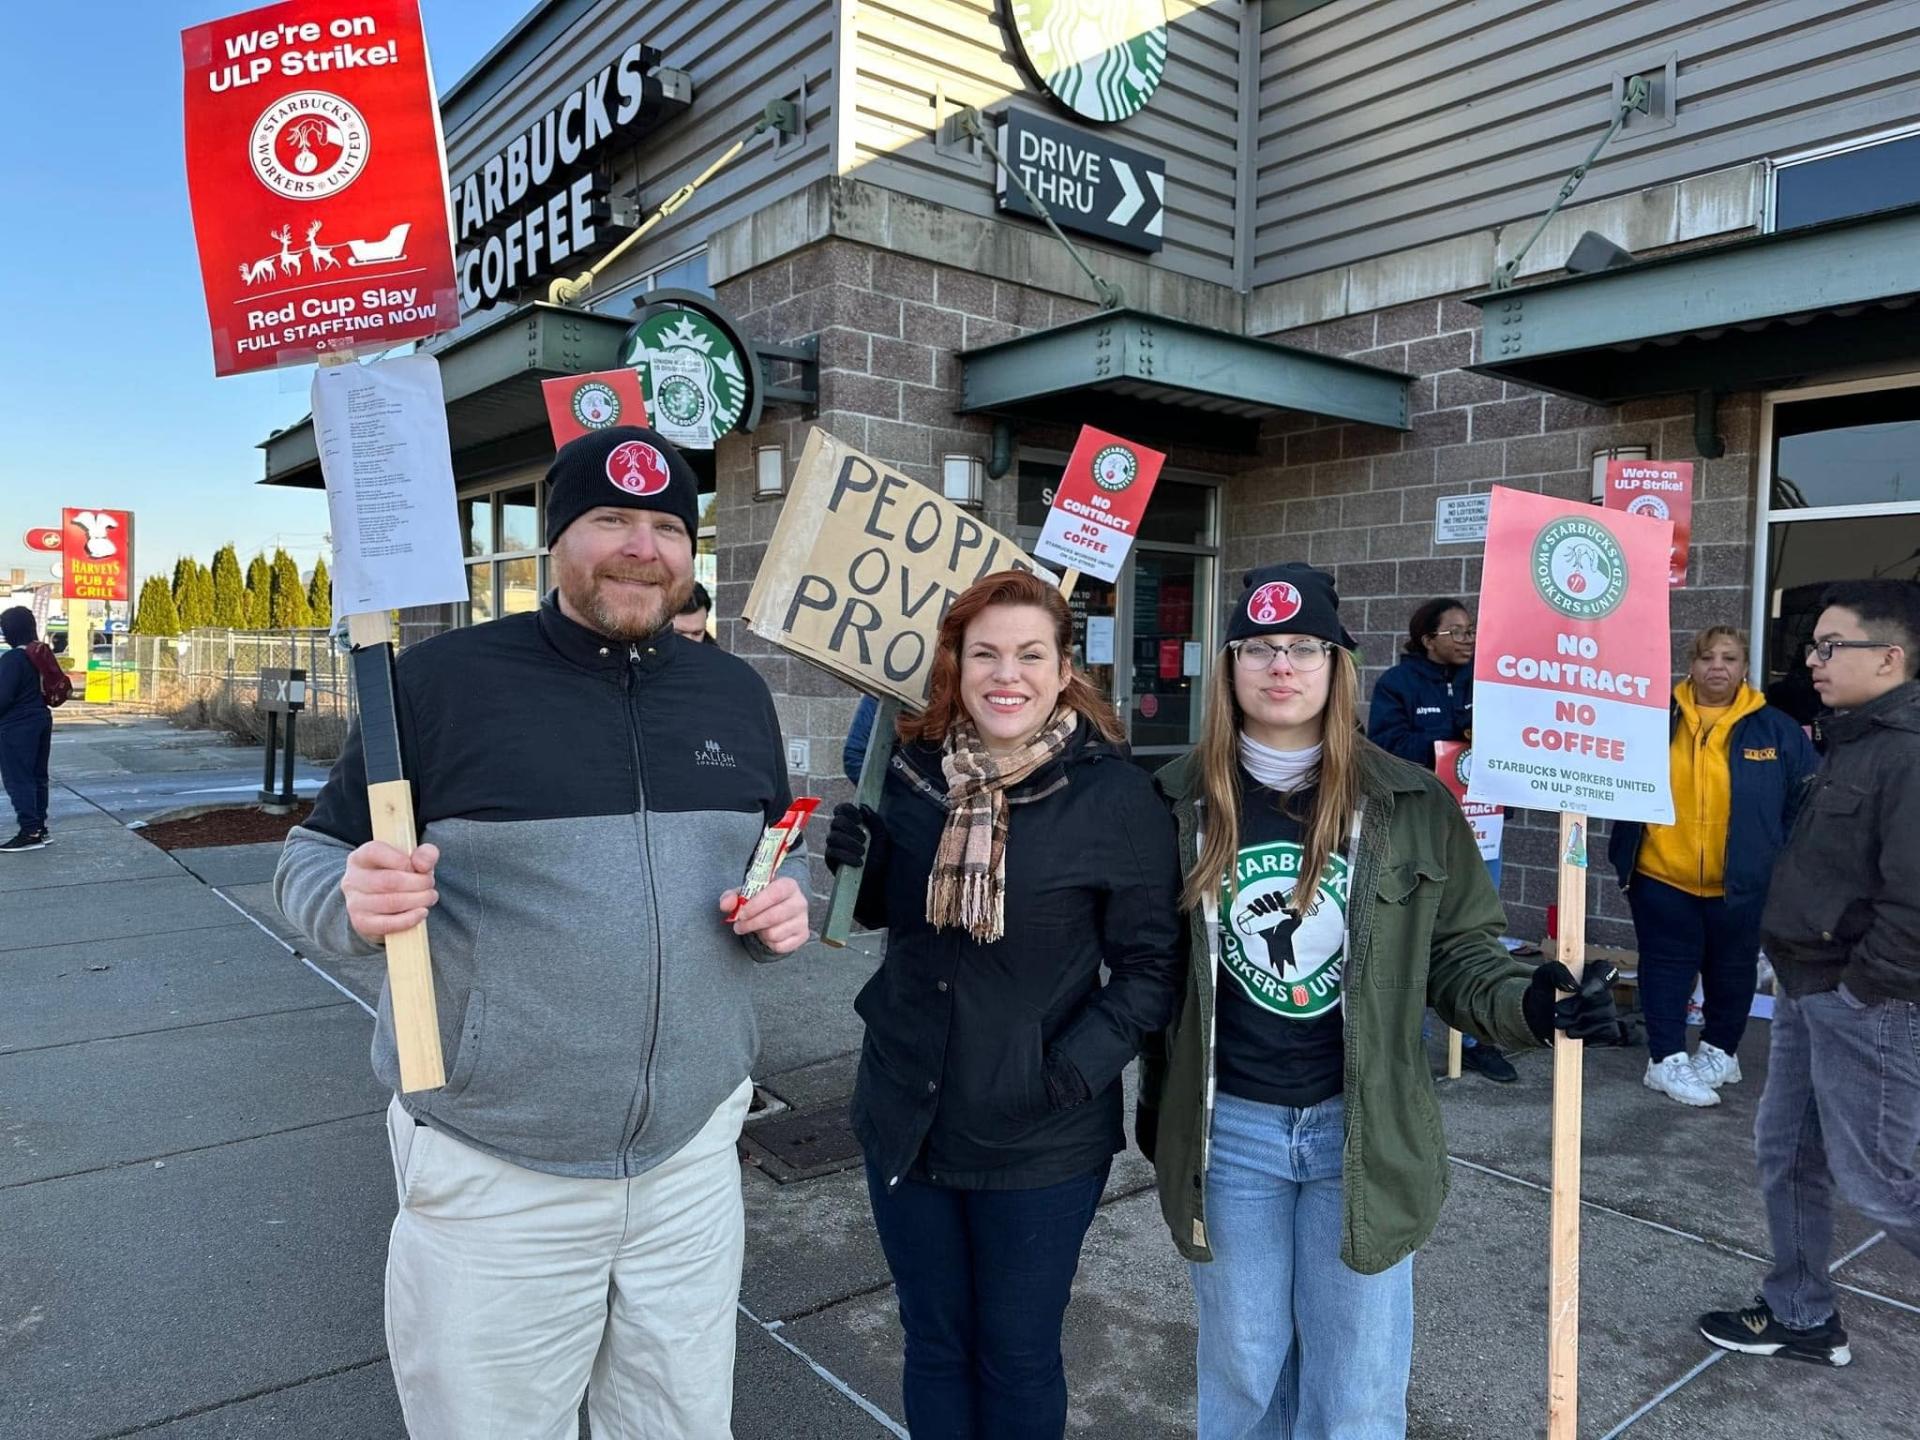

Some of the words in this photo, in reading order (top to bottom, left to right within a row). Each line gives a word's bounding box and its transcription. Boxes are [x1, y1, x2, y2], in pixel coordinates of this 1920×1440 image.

[225, 24, 321, 59] We're
[329, 15, 376, 42] on
[209, 56, 273, 93] ULP
[281, 41, 399, 77] Strike!
[264, 98, 352, 134] STARBUCKS
[326, 131, 362, 187] UNITED
[450, 43, 643, 244] TARBUCKS
[1019, 129, 1100, 183] DRIVE
[258, 144, 316, 193] WORKERS
[1019, 164, 1094, 213] THRU
[462, 172, 596, 310] COFFEE
[248, 306, 295, 331] Red
[301, 298, 356, 321] Cup
[362, 287, 418, 312] Slay
[237, 332, 280, 354] FULL
[283, 316, 385, 342] STAFFING
[388, 304, 437, 327] NOW
[1614, 479, 1640, 490] ULP
[1642, 480, 1683, 491] Strike!
[1622, 467, 1659, 479] We're
[1661, 470, 1677, 479] on
[1063, 498, 1131, 532] CONTRACT
[1091, 494, 1111, 510] NO
[827, 455, 1033, 588] PEOPL
[1081, 523, 1100, 537] NO
[1063, 531, 1109, 554] COFFEE
[1545, 521, 1618, 560] STARBUCKS
[74, 575, 103, 586] PUB
[106, 576, 116, 586] &
[76, 586, 113, 598] GRILL
[1538, 551, 1582, 612] WORKERS
[1590, 568, 1624, 614] UNITED
[782, 575, 932, 700] PRO
[1557, 633, 1598, 659] NO
[1497, 655, 1651, 699] CONTRACT
[1555, 701, 1596, 726] NO
[695, 750, 735, 764] SALISH
[1522, 727, 1626, 762] COFFEE
[1488, 759, 1557, 779] STARBUCKS
[1560, 769, 1613, 787] WORKERS
[1616, 778, 1656, 794] UNITED
[1530, 779, 1549, 792] ON
[1551, 782, 1573, 795] ULP
[1574, 786, 1615, 802] STRIKE!
[1461, 804, 1497, 814] TRACT
